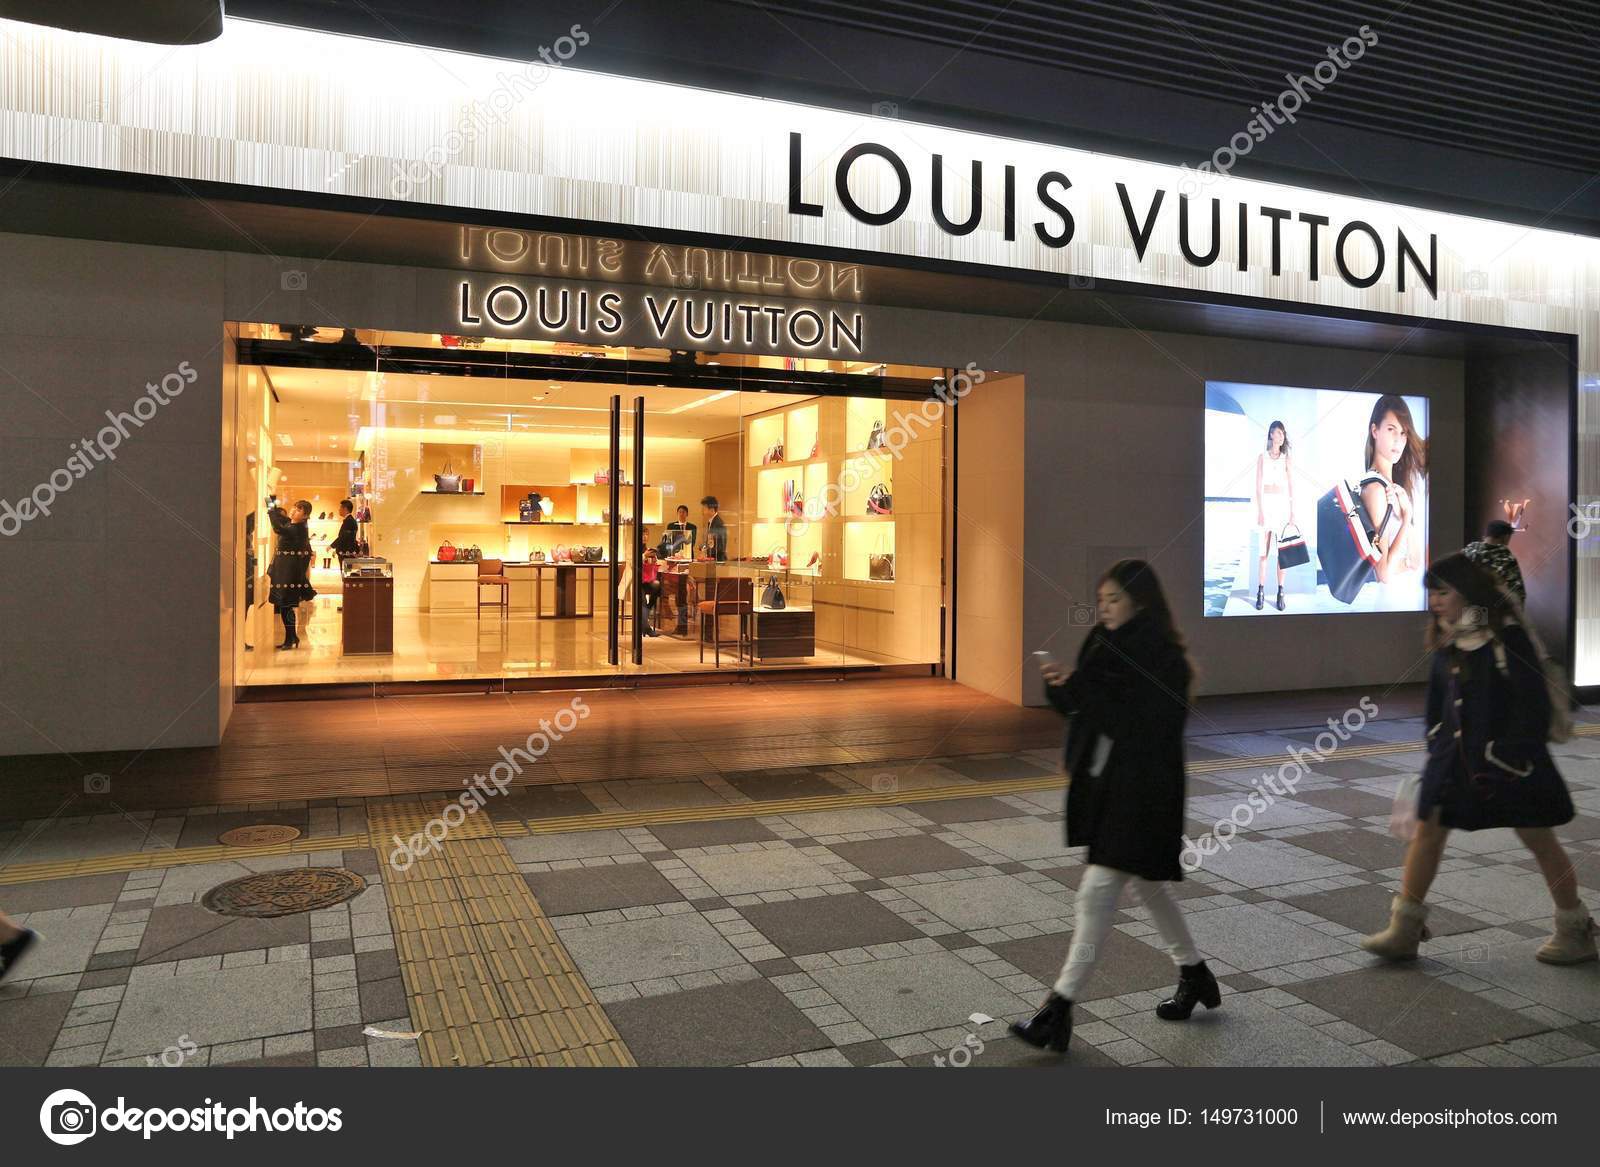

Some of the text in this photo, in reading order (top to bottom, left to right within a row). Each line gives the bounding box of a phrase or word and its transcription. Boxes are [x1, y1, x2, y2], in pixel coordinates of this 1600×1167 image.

[789, 131, 1438, 301] LOUIS VUITTON
[460, 281, 864, 353] LOUIS VUITTON
